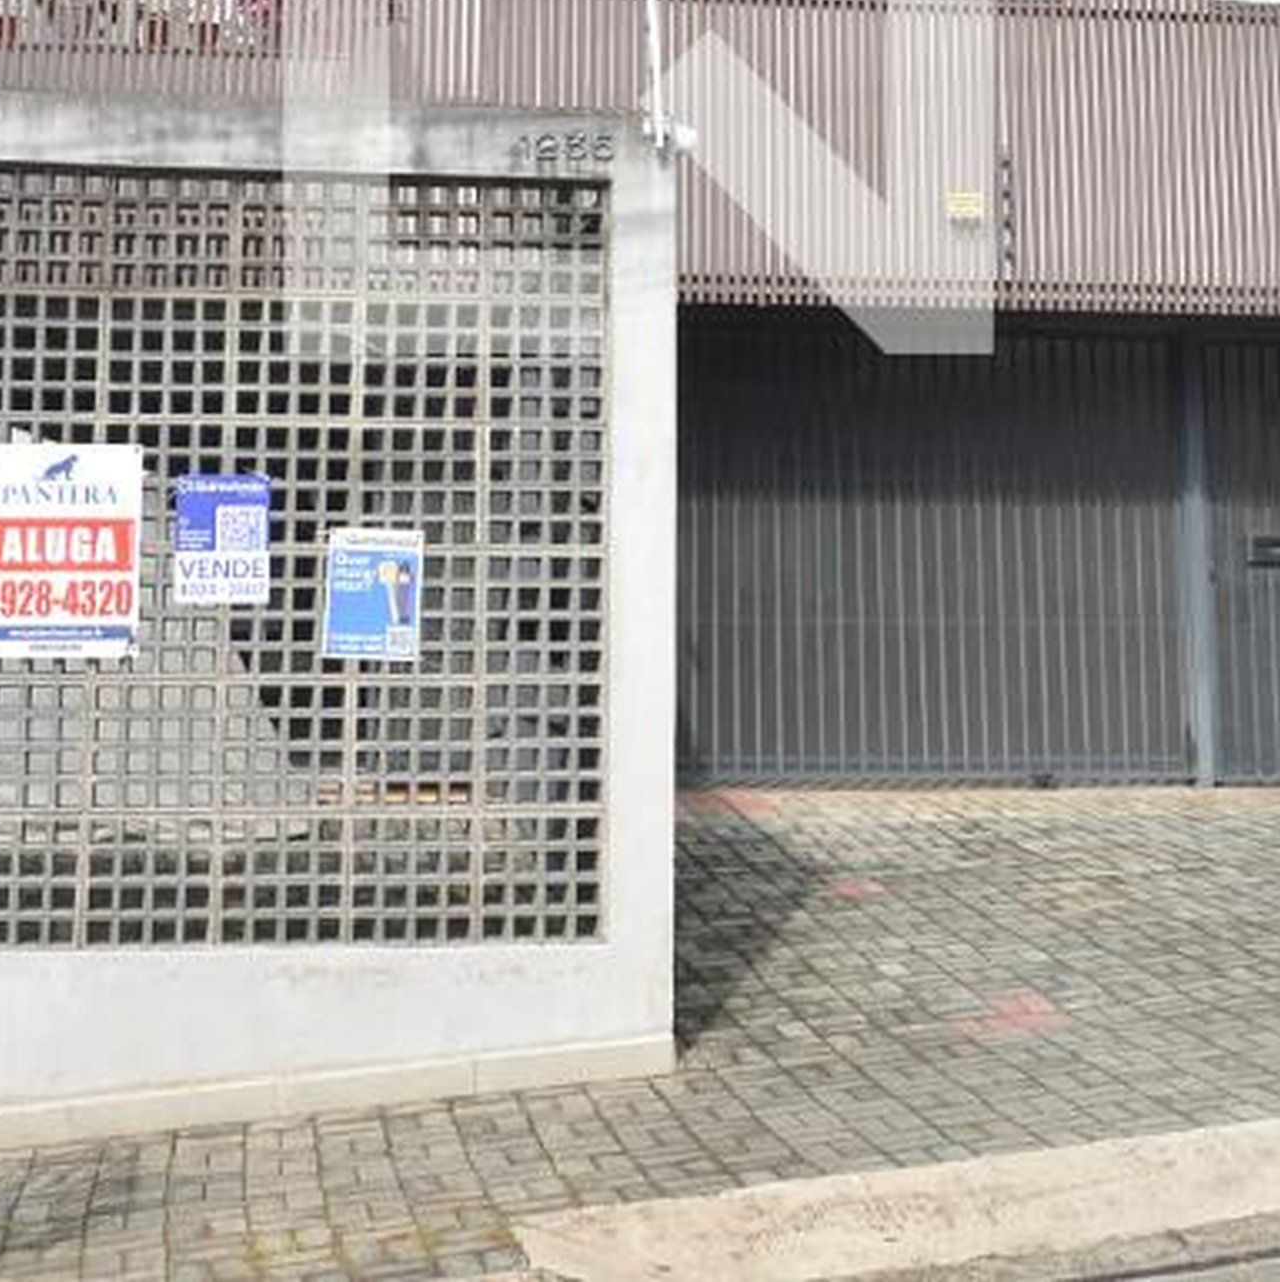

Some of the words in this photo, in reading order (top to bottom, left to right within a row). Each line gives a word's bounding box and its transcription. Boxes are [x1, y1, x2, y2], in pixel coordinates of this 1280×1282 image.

[1, 483, 119, 506] PANTERA
[0, 525, 118, 564] ALUGA
[178, 558, 266, 579] VENDE
